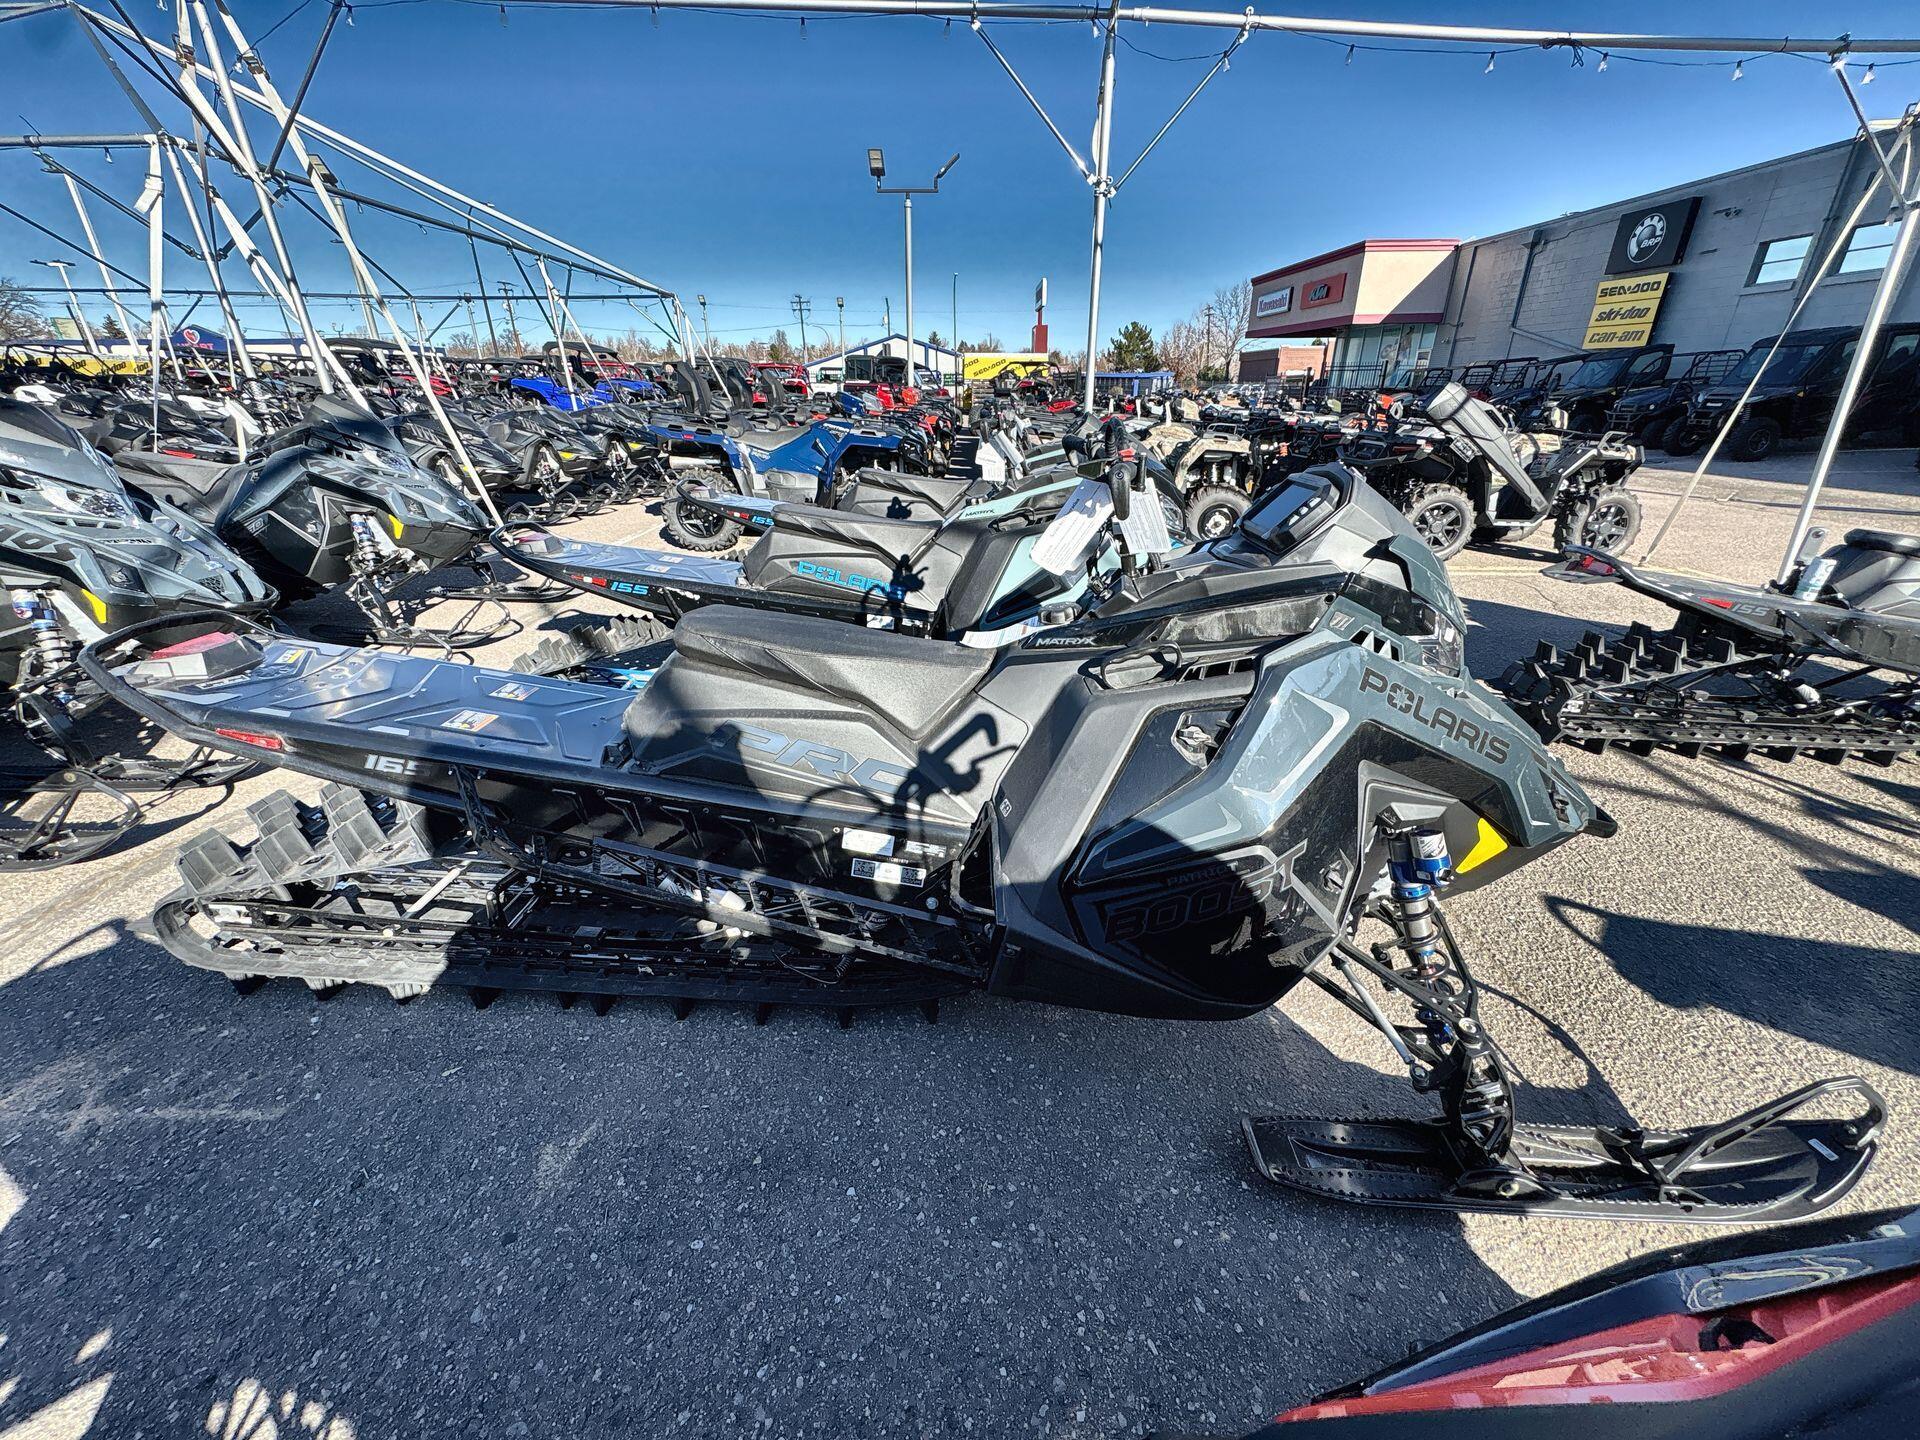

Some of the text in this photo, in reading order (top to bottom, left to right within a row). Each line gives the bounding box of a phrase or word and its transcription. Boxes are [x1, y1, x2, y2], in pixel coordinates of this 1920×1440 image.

[1640, 237, 1661, 249] BRP
[1258, 293, 1288, 313] Kawasaki
[1594, 306, 1651, 322] ski-doo
[1588, 330, 1645, 344] can-am
[751, 515, 775, 526] 155
[965, 508, 996, 518] MATRYX
[611, 581, 649, 596] 155
[1731, 601, 1770, 617] 155
[1035, 636, 1098, 647] MATRYX
[1358, 666, 1511, 765] POLARIS
[364, 754, 434, 777] 165
[1166, 861, 1239, 887] PATRIOT
[1104, 838, 1308, 944] BOOST
